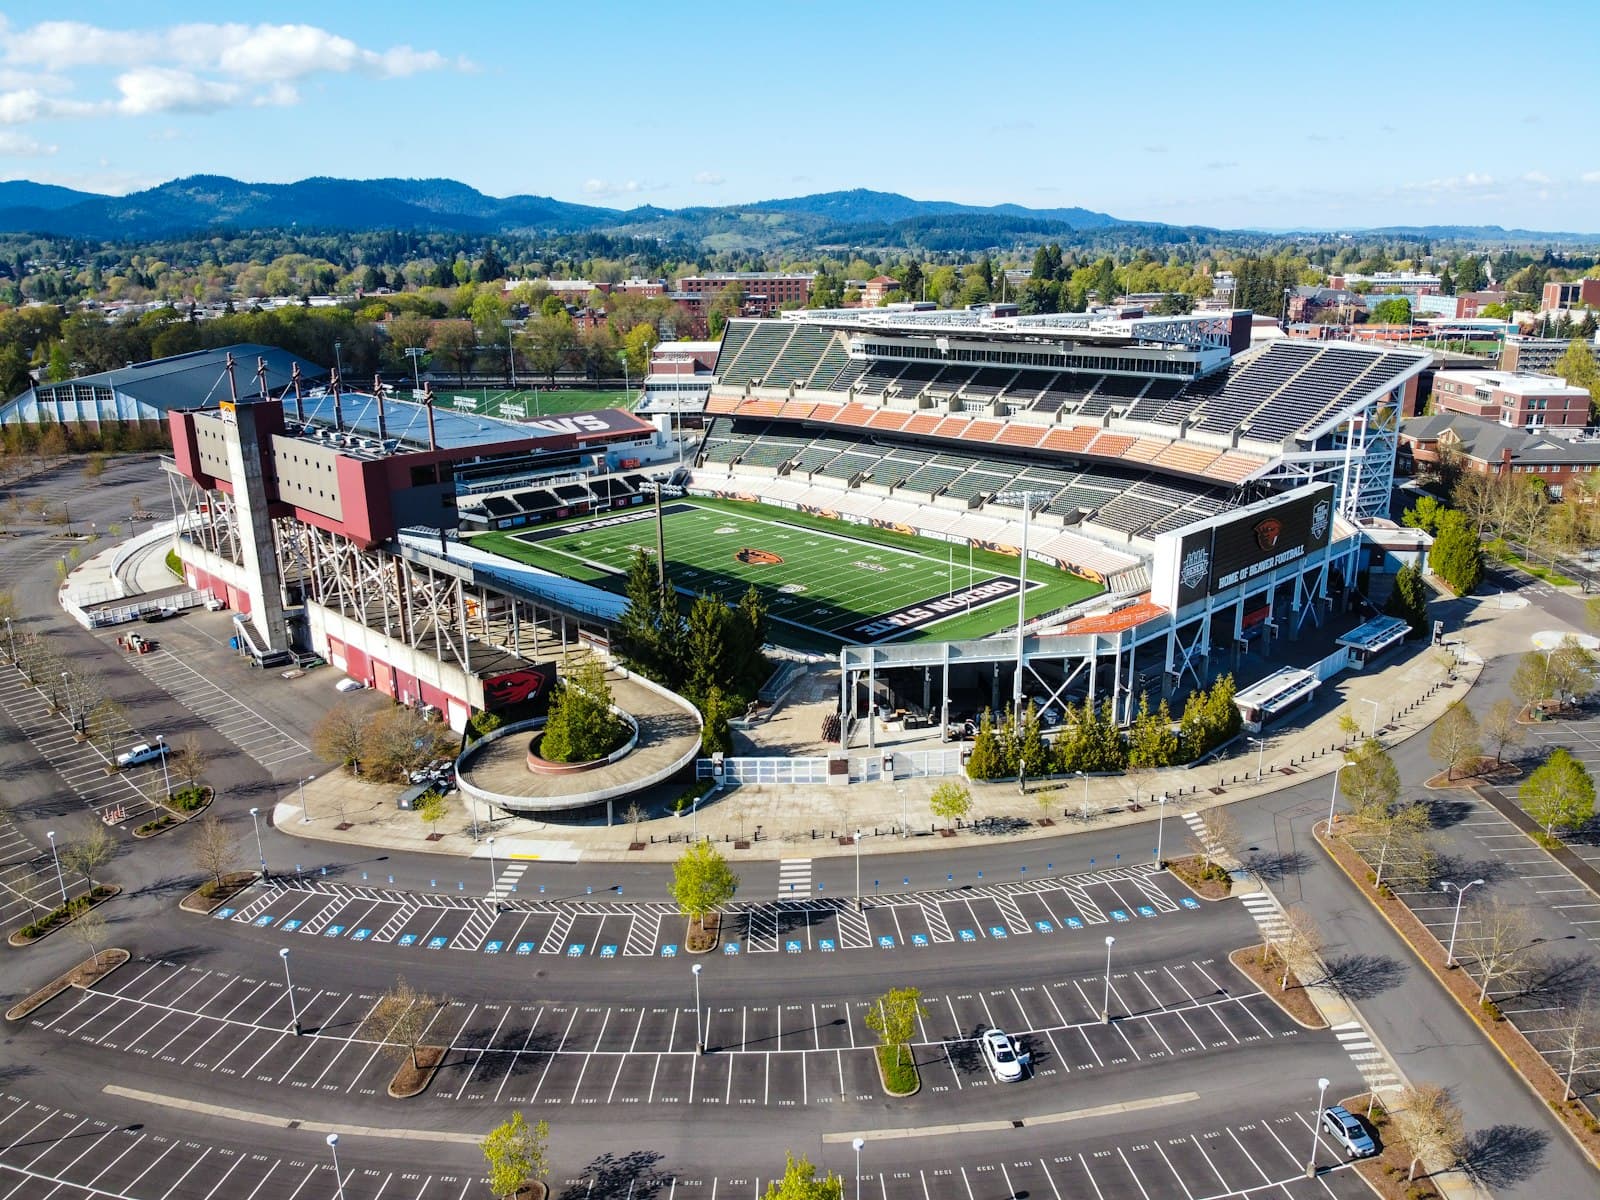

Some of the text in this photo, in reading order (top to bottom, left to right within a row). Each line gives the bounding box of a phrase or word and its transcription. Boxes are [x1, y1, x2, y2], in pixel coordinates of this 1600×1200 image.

[1218, 544, 1305, 590] HOME OF BEAVER FOOTBALL
[853, 581, 1018, 636] OREGON STATE
